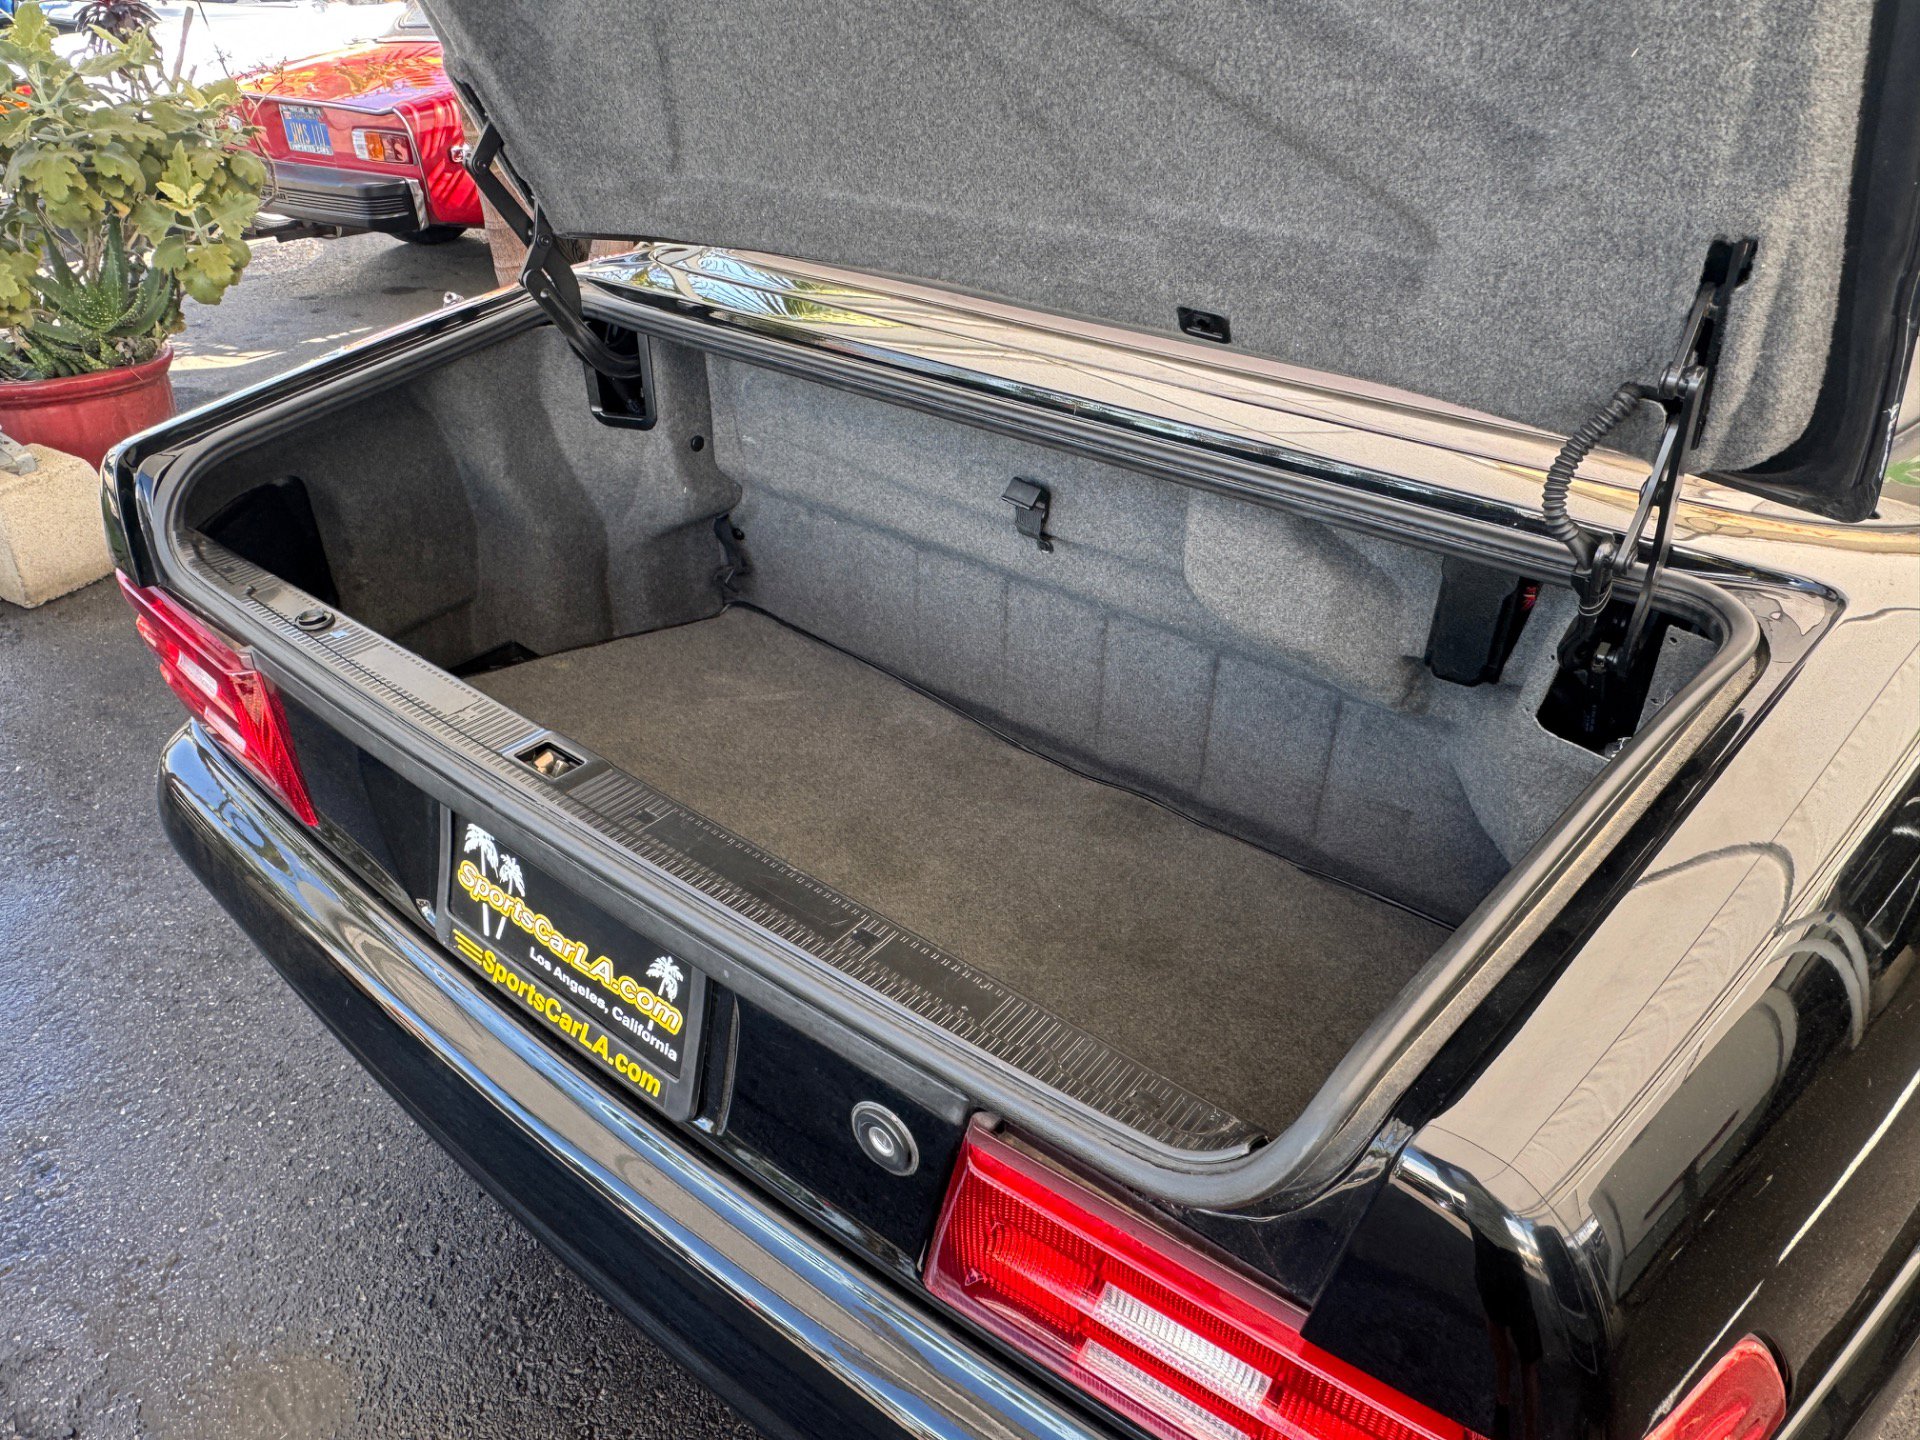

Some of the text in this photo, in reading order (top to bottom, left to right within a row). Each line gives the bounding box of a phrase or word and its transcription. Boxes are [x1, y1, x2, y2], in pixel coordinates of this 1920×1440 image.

[457, 860, 683, 1035] SportsCarLA.com
[529, 946, 678, 1062] Los Angeles, California
[481, 950, 661, 1098] SportsCarLA.com
